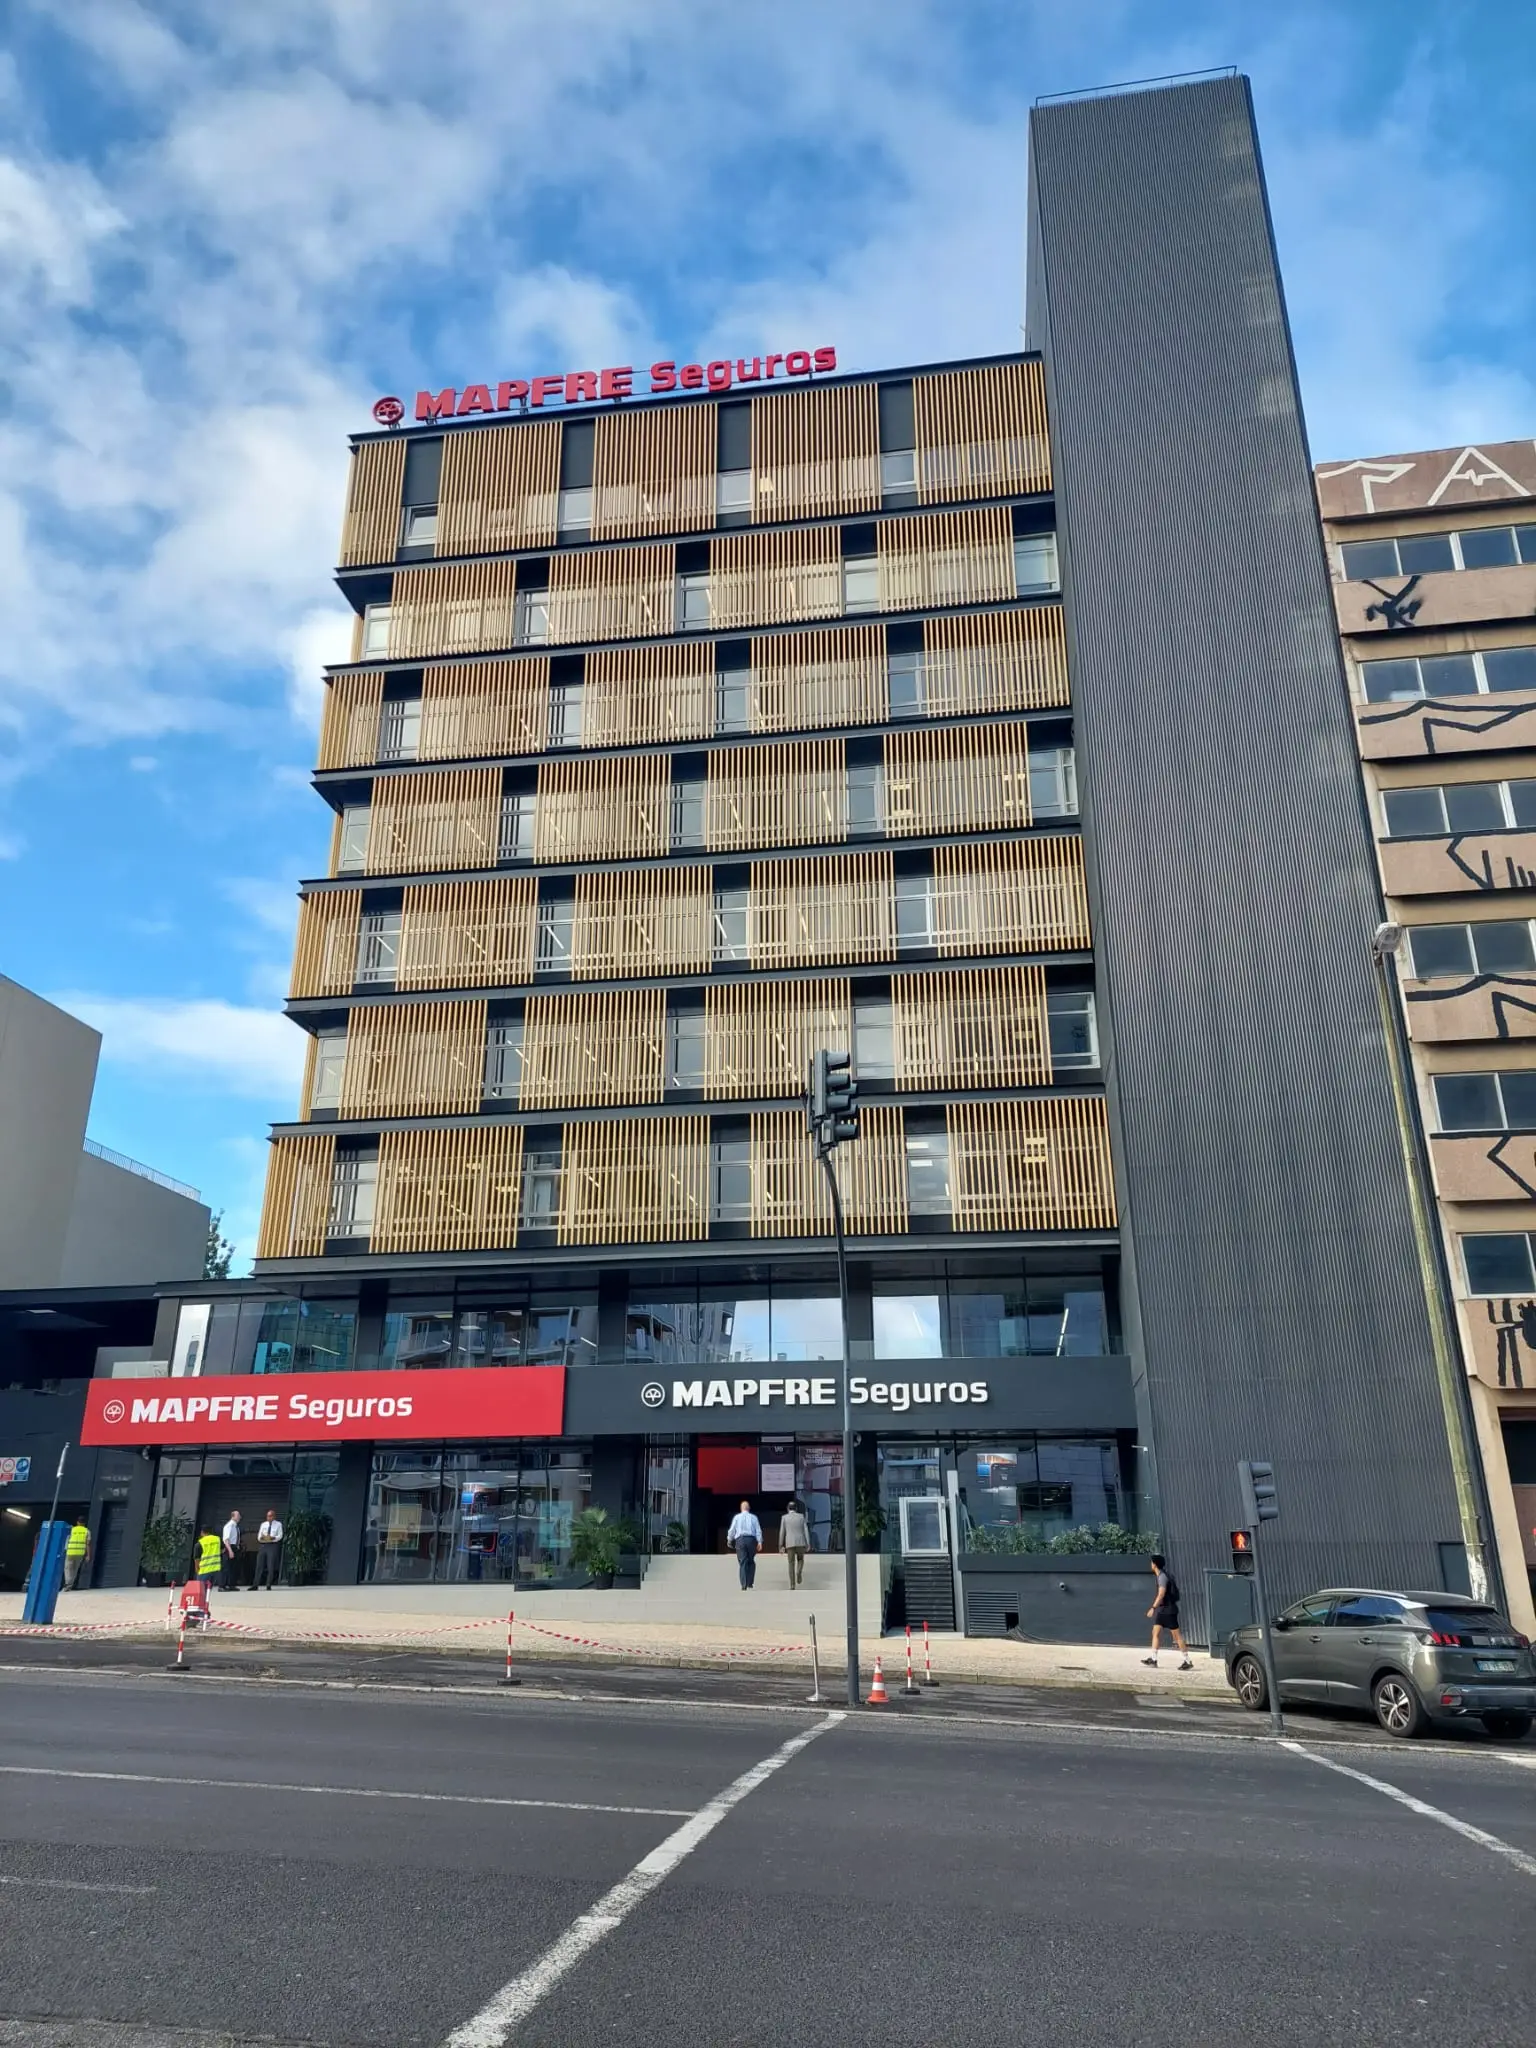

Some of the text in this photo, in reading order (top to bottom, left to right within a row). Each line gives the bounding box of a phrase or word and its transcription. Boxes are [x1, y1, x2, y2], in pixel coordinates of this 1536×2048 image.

[415, 346, 837, 421] MAPFRE Seguros
[130, 1394, 413, 1426] MAPFRE Seguros
[672, 1377, 988, 1411] MAPFRE Seguros
